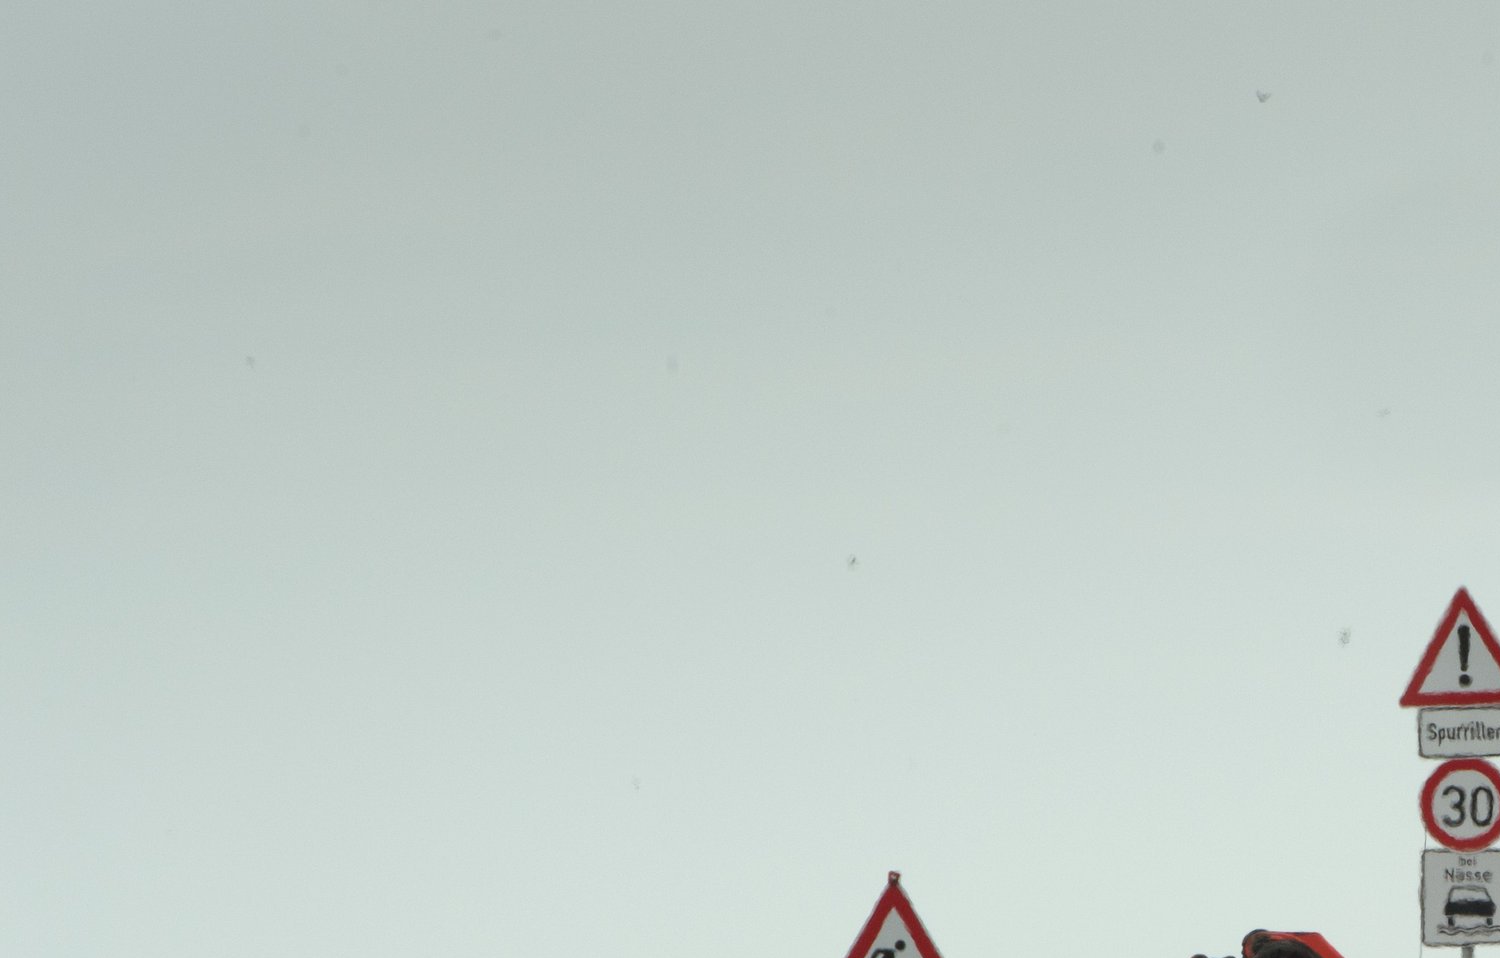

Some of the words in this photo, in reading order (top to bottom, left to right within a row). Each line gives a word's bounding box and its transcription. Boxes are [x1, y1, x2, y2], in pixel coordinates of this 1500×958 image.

[1442, 785, 1494, 827] 30
[1458, 855, 1477, 866] bei
[1444, 866, 1493, 883] Nässe
